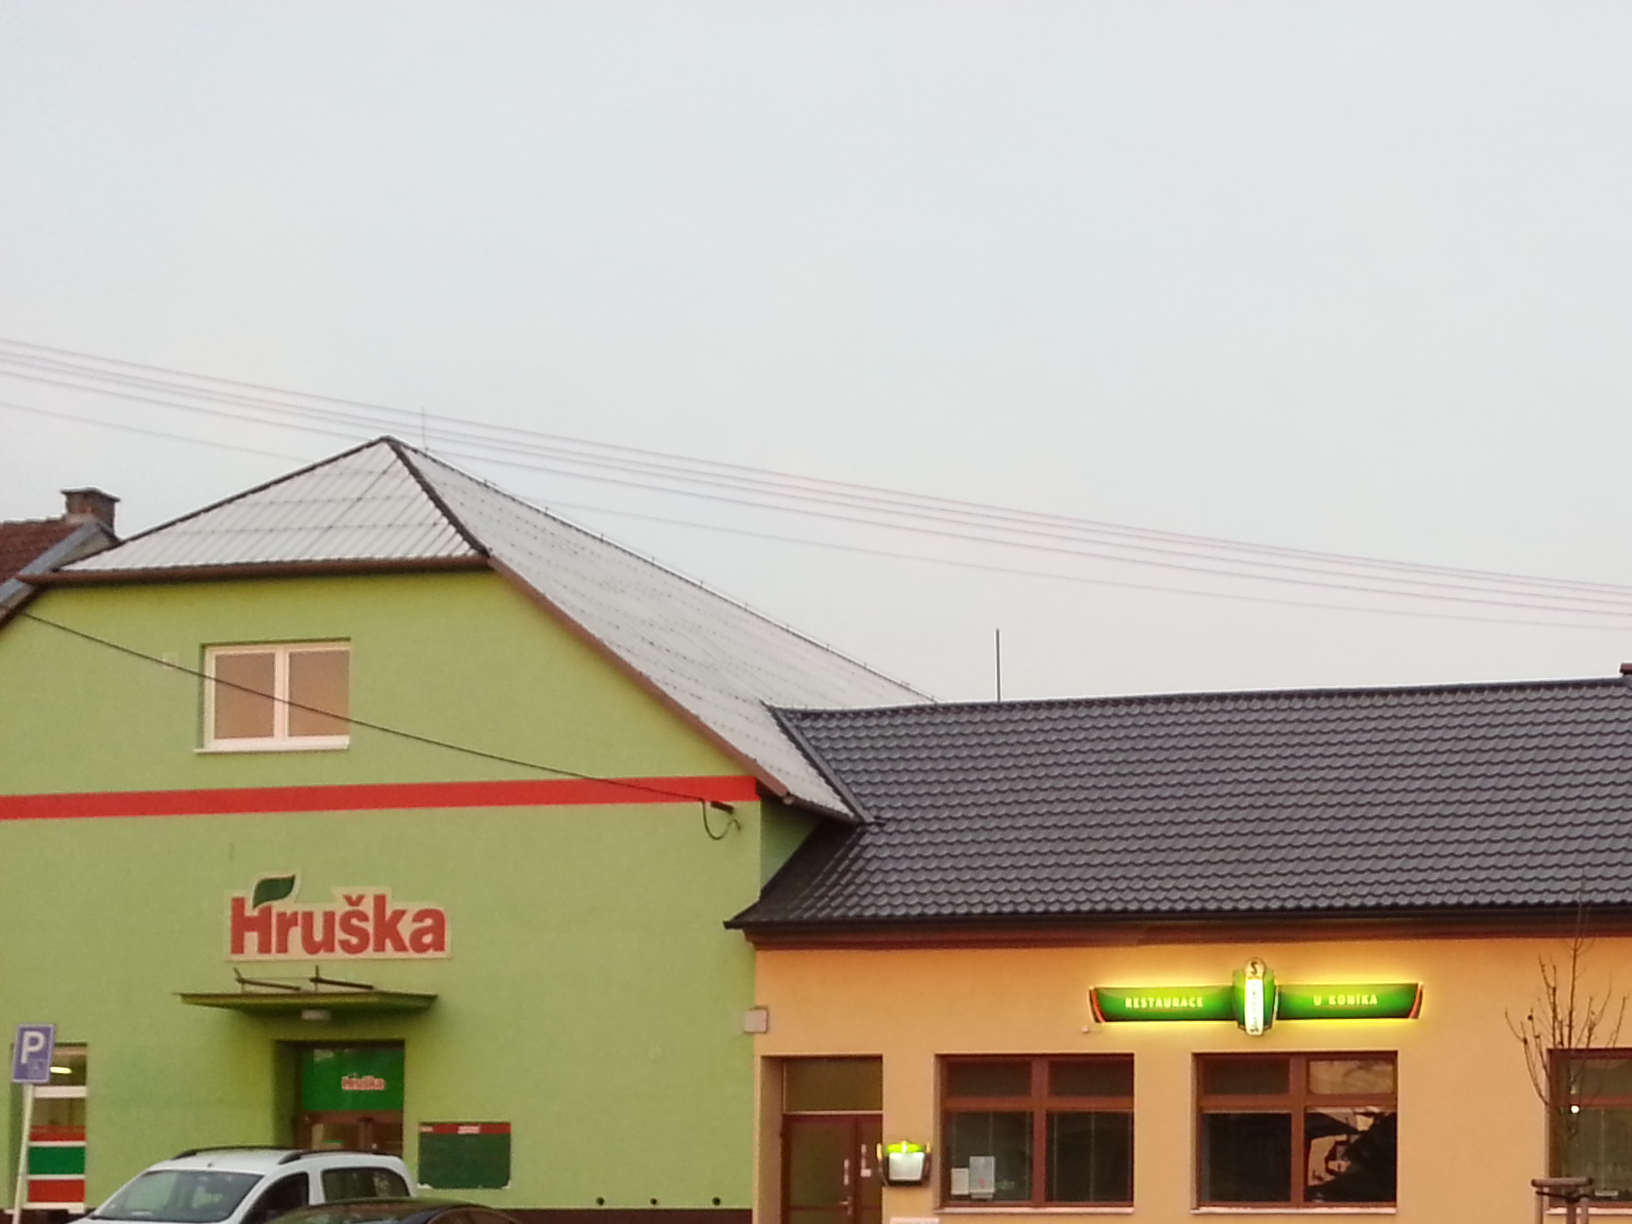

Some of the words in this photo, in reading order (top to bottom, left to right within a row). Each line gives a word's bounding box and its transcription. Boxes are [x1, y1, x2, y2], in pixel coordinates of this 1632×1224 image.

[231, 894, 447, 955] Hruška
[1125, 996, 1204, 1008] RESTAURACE
[1313, 995, 1322, 1006] U
[21, 1031, 46, 1064] P
